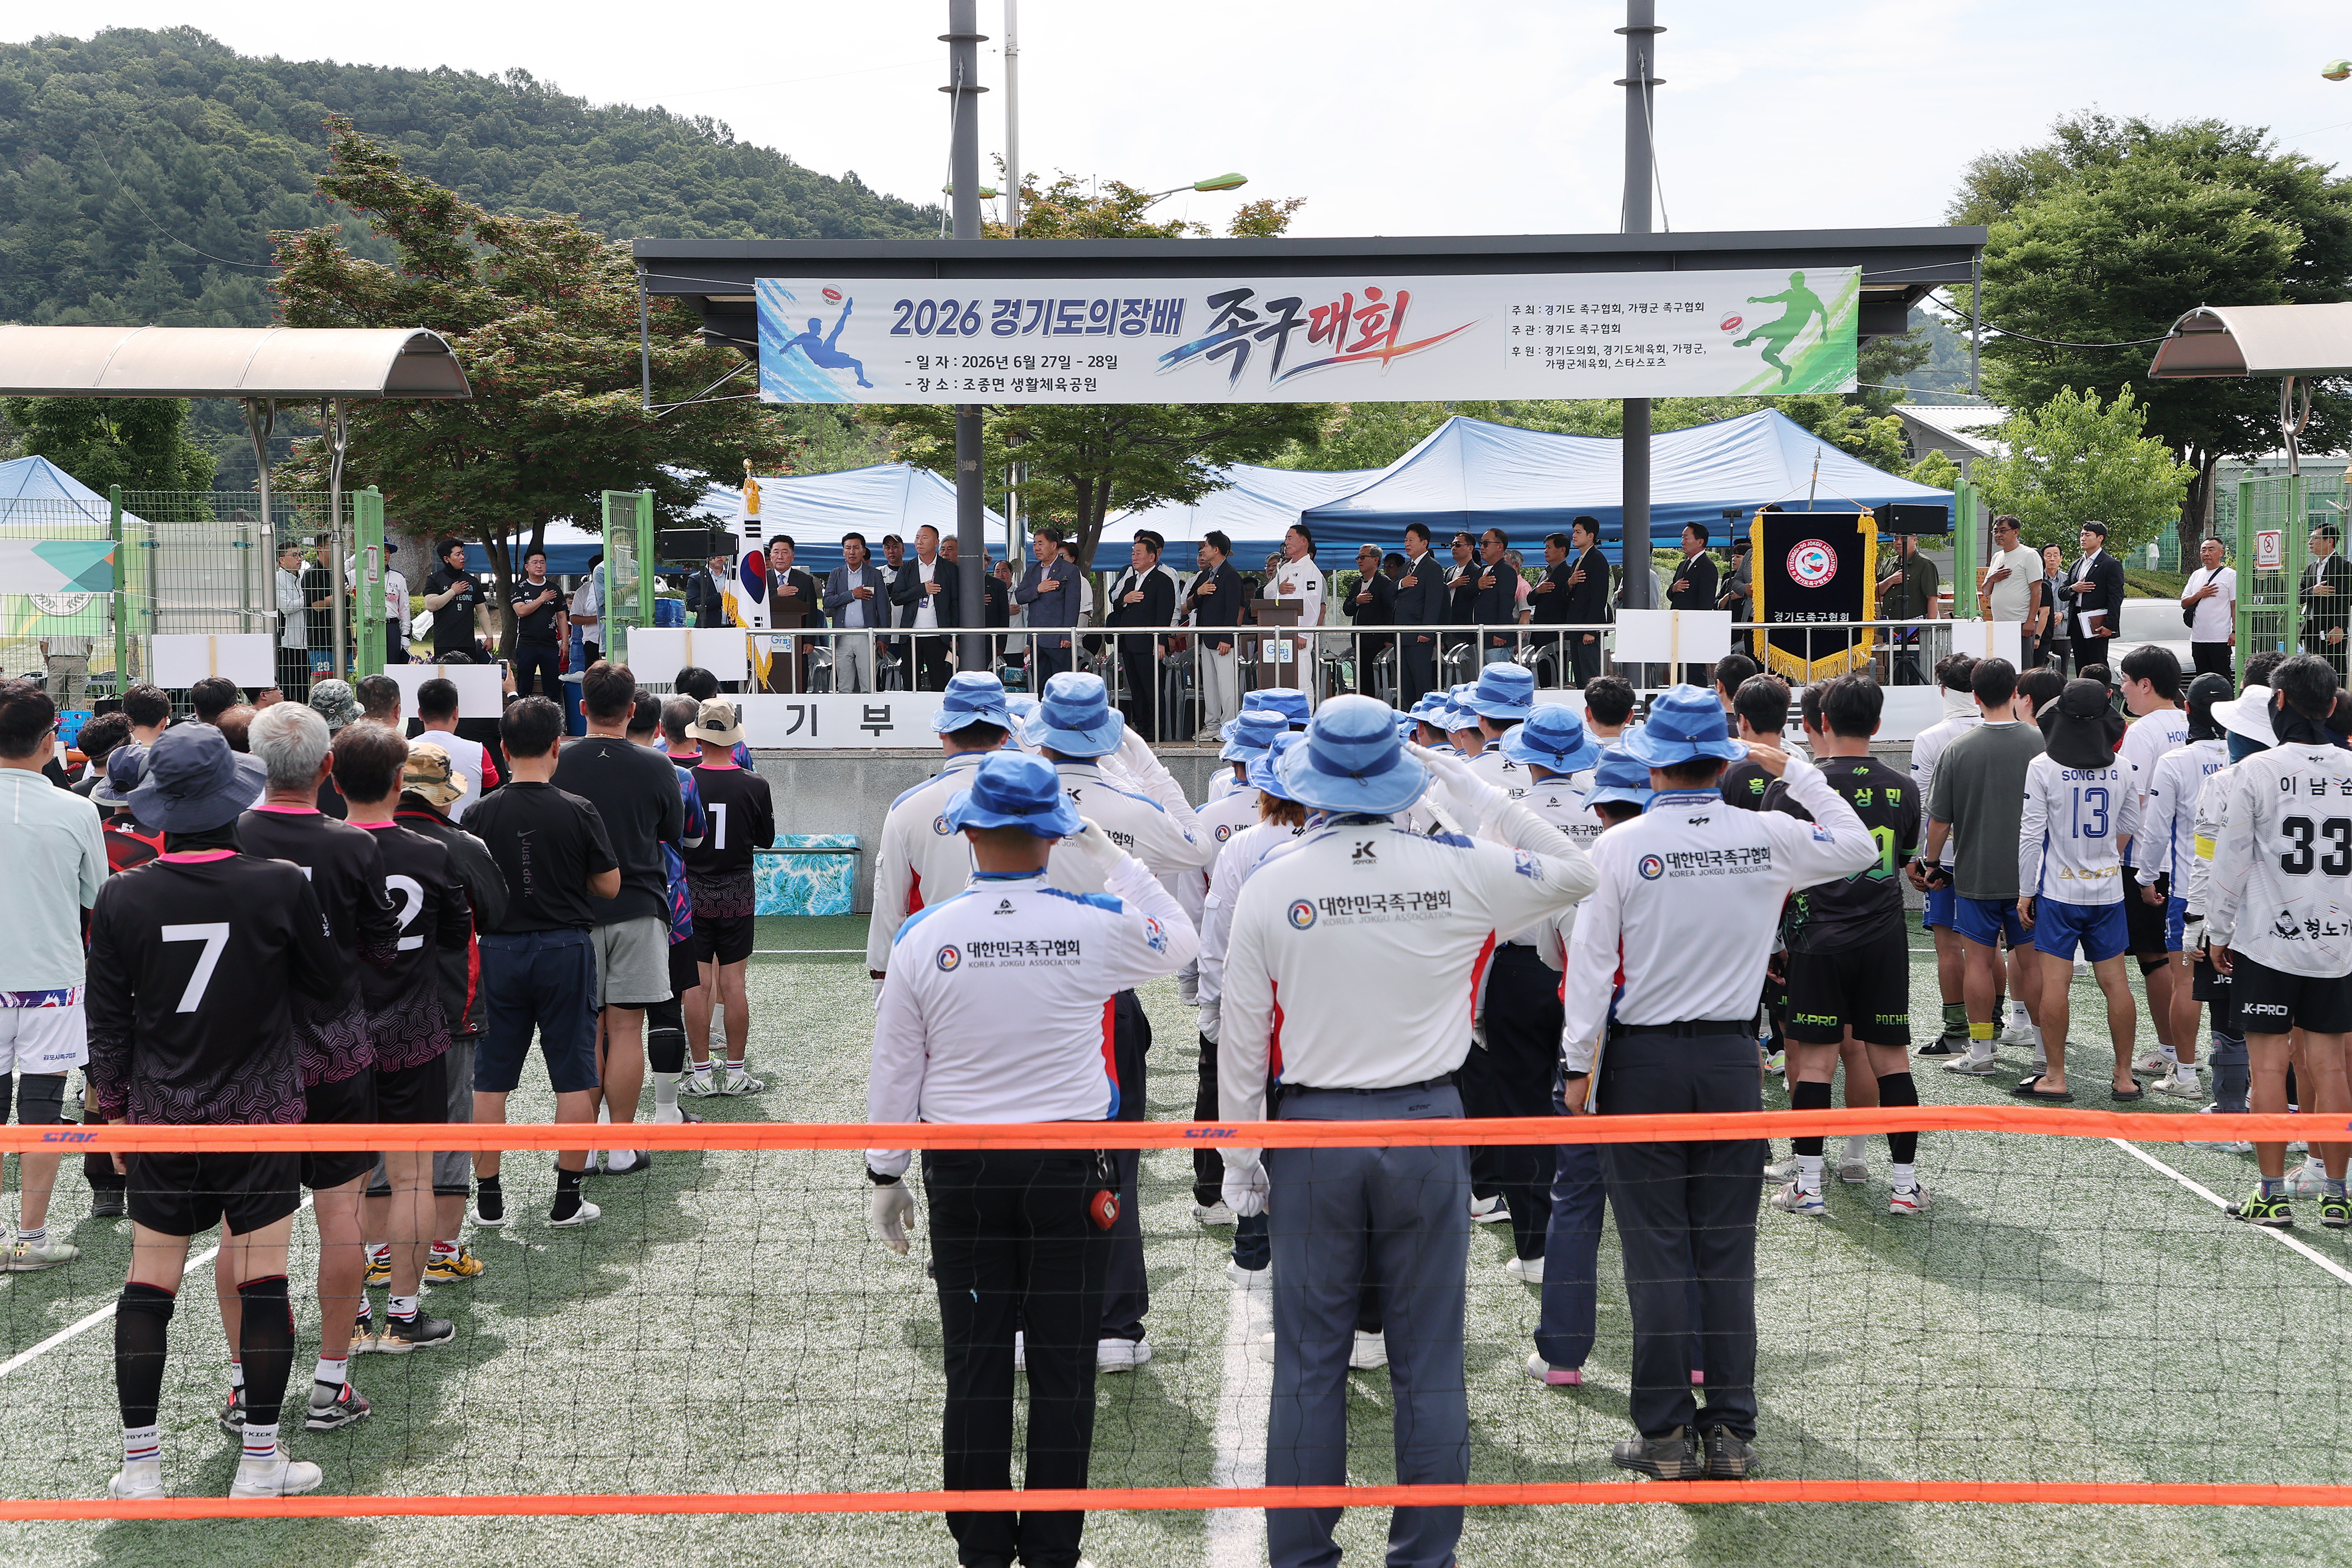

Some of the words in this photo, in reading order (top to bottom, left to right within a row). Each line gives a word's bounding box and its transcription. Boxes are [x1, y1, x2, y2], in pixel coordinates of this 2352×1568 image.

[1546, 305, 1575, 315] 경기도
[1580, 304, 1624, 315] 족구협회,
[1628, 303, 1658, 313] 가평군
[1663, 302, 1704, 312] 족구협회
[1546, 325, 1575, 335] 경기도
[1580, 324, 1621, 334] 족구협회
[890, 298, 983, 337] 2026
[991, 298, 1187, 337] 경기도의장배
[1158, 286, 1434, 393] 족구대회
[1546, 346, 1599, 357] 경기도의회,
[1604, 344, 1669, 356] 경기도체육회,
[1673, 344, 1706, 356] 가평군,
[962, 356, 1009, 370] 2026년
[1014, 356, 1035, 370] 6월
[1042, 356, 1071, 370] 27일
[1088, 356, 1117, 370] 28일
[1546, 359, 1611, 370] 가평군체육회,
[1615, 357, 1666, 367] 스타스포츠
[963, 378, 1005, 392] 조종면
[1010, 377, 1096, 392] 생활체육공원
[1822, 544, 1836, 572] ASSOCIATION
[457, 603, 462, 612] 9
[1774, 612, 1850, 622] 경기도족구협회
[317, 661, 330, 671] 29
[2167, 730, 2190, 743] HON
[2062, 770, 2095, 781] SONG
[2099, 769, 2106, 780] J
[2111, 769, 2118, 781] G
[1749, 778, 1765, 795] 홍
[1854, 788, 1873, 808] 상
[1886, 788, 1901, 808] 민
[2073, 787, 2110, 838] 13
[708, 803, 726, 850] 1
[521, 838, 532, 865] Just
[2280, 814, 2352, 877] 33
[1666, 847, 1771, 869] 대한민국족구협회
[522, 869, 532, 884] do
[1729, 865, 1772, 874] ASSOCIATION
[524, 888, 533, 897] it.
[1319, 890, 1452, 916] 대한민국족구협회
[385, 874, 425, 951] 2
[1323, 917, 1354, 927] KOREA
[1359, 915, 1390, 924] JOKGU
[1395, 911, 1452, 922] ASSOCIATION
[967, 940, 1080, 958] 대한민국족구협회
[161, 922, 230, 1013] 7
[2241, 1003, 2289, 1016] JK-PRO
[1792, 1012, 1838, 1026] JK-PRO
